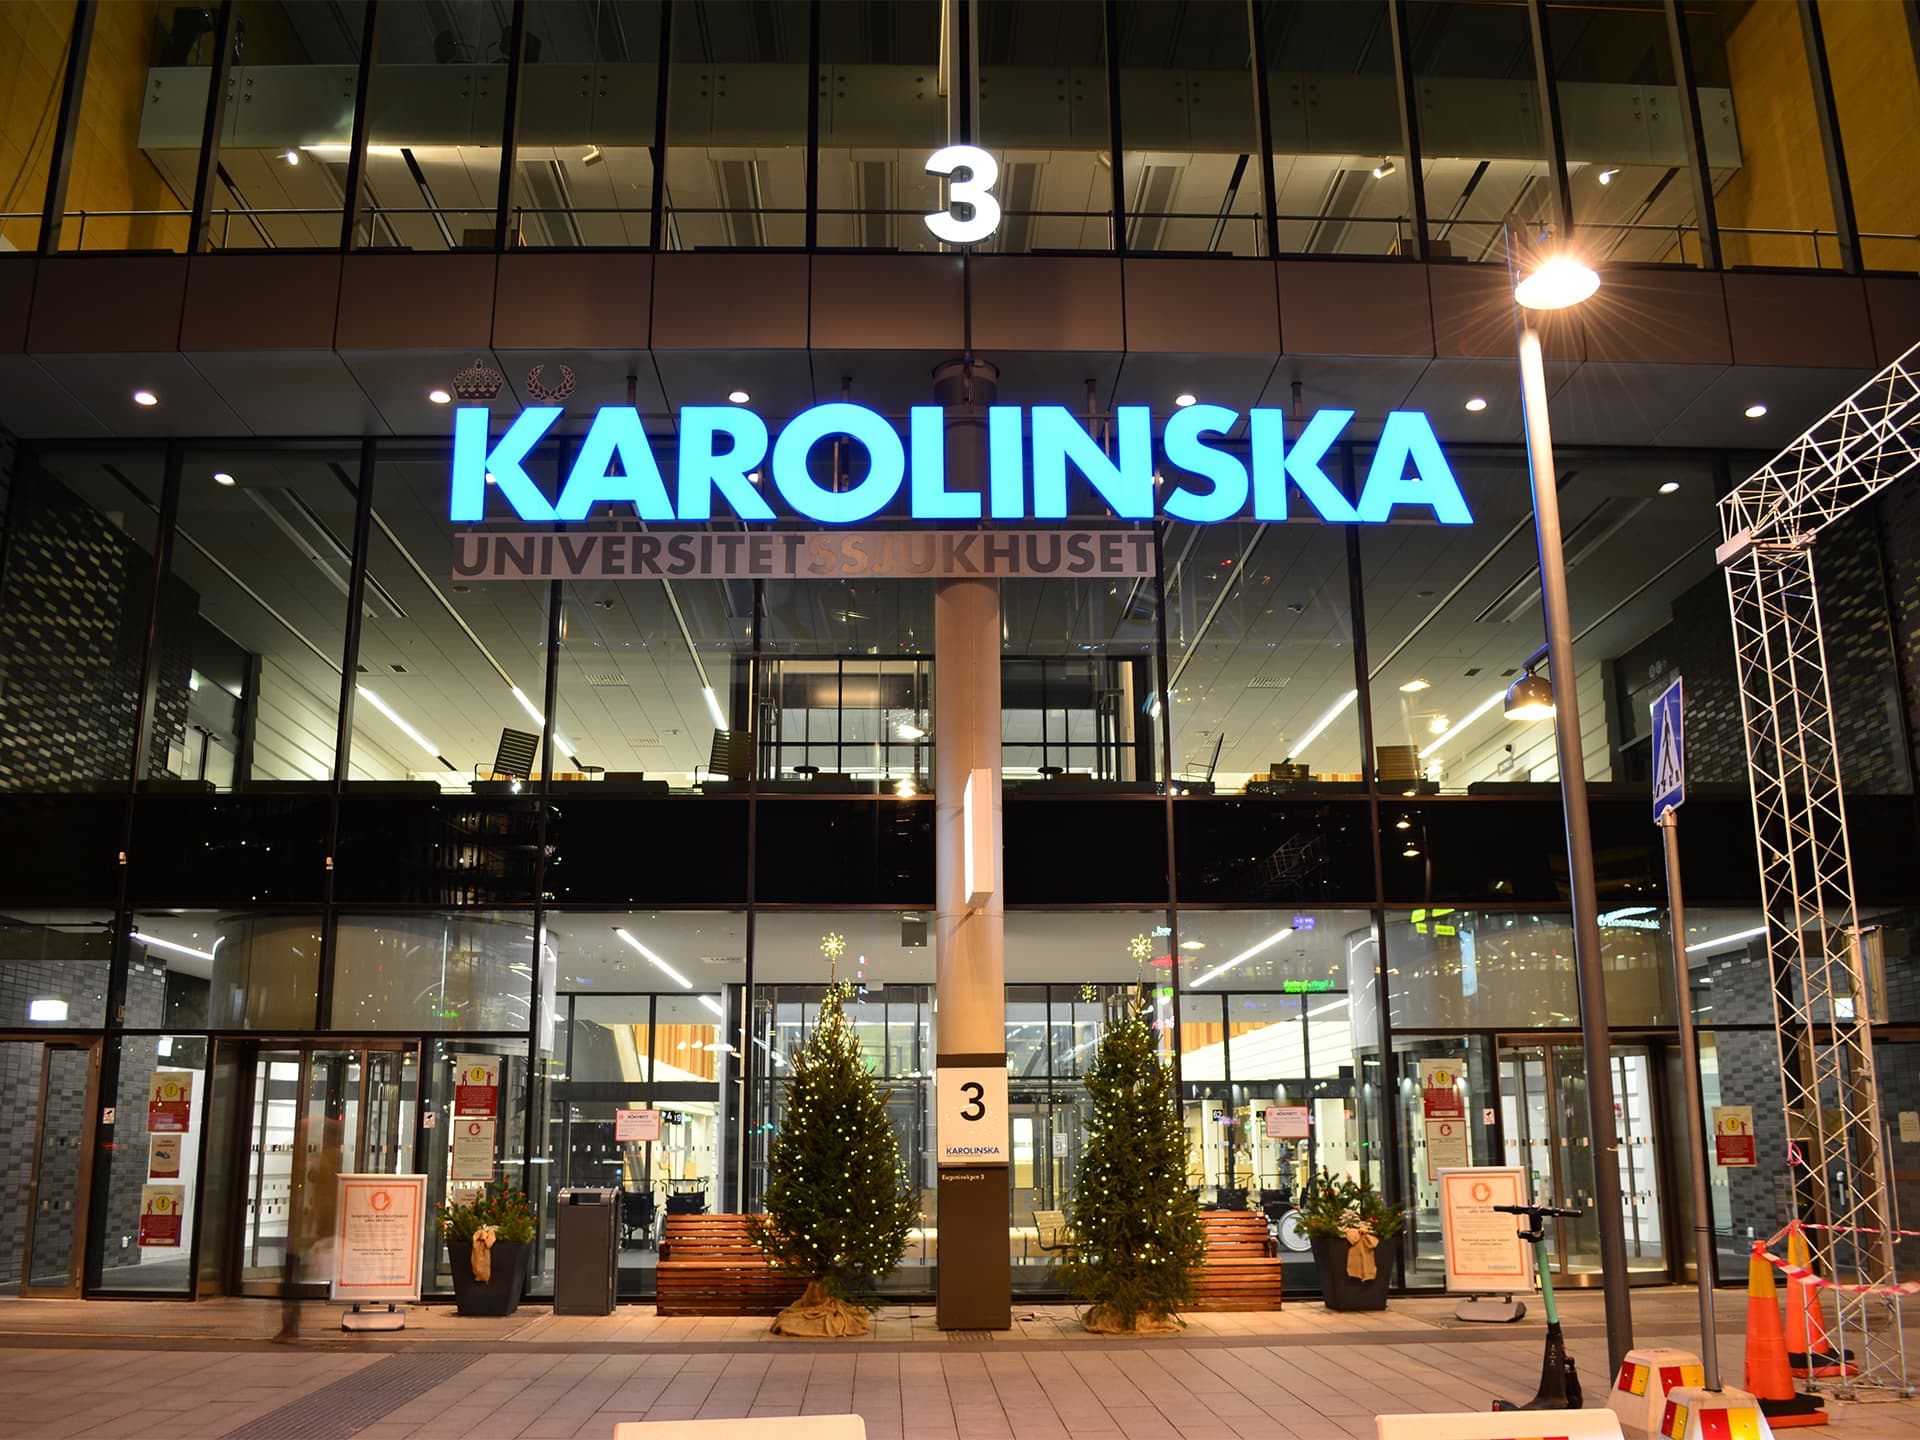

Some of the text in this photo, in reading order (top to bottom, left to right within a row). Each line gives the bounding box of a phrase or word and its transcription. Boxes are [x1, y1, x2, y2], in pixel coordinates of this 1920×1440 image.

[923, 145, 1001, 244] 3
[450, 402, 1473, 526] KAROLINSKA
[453, 532, 1155, 577] UNIVERSITETSSJUKHUSET
[960, 1082, 986, 1121] 3
